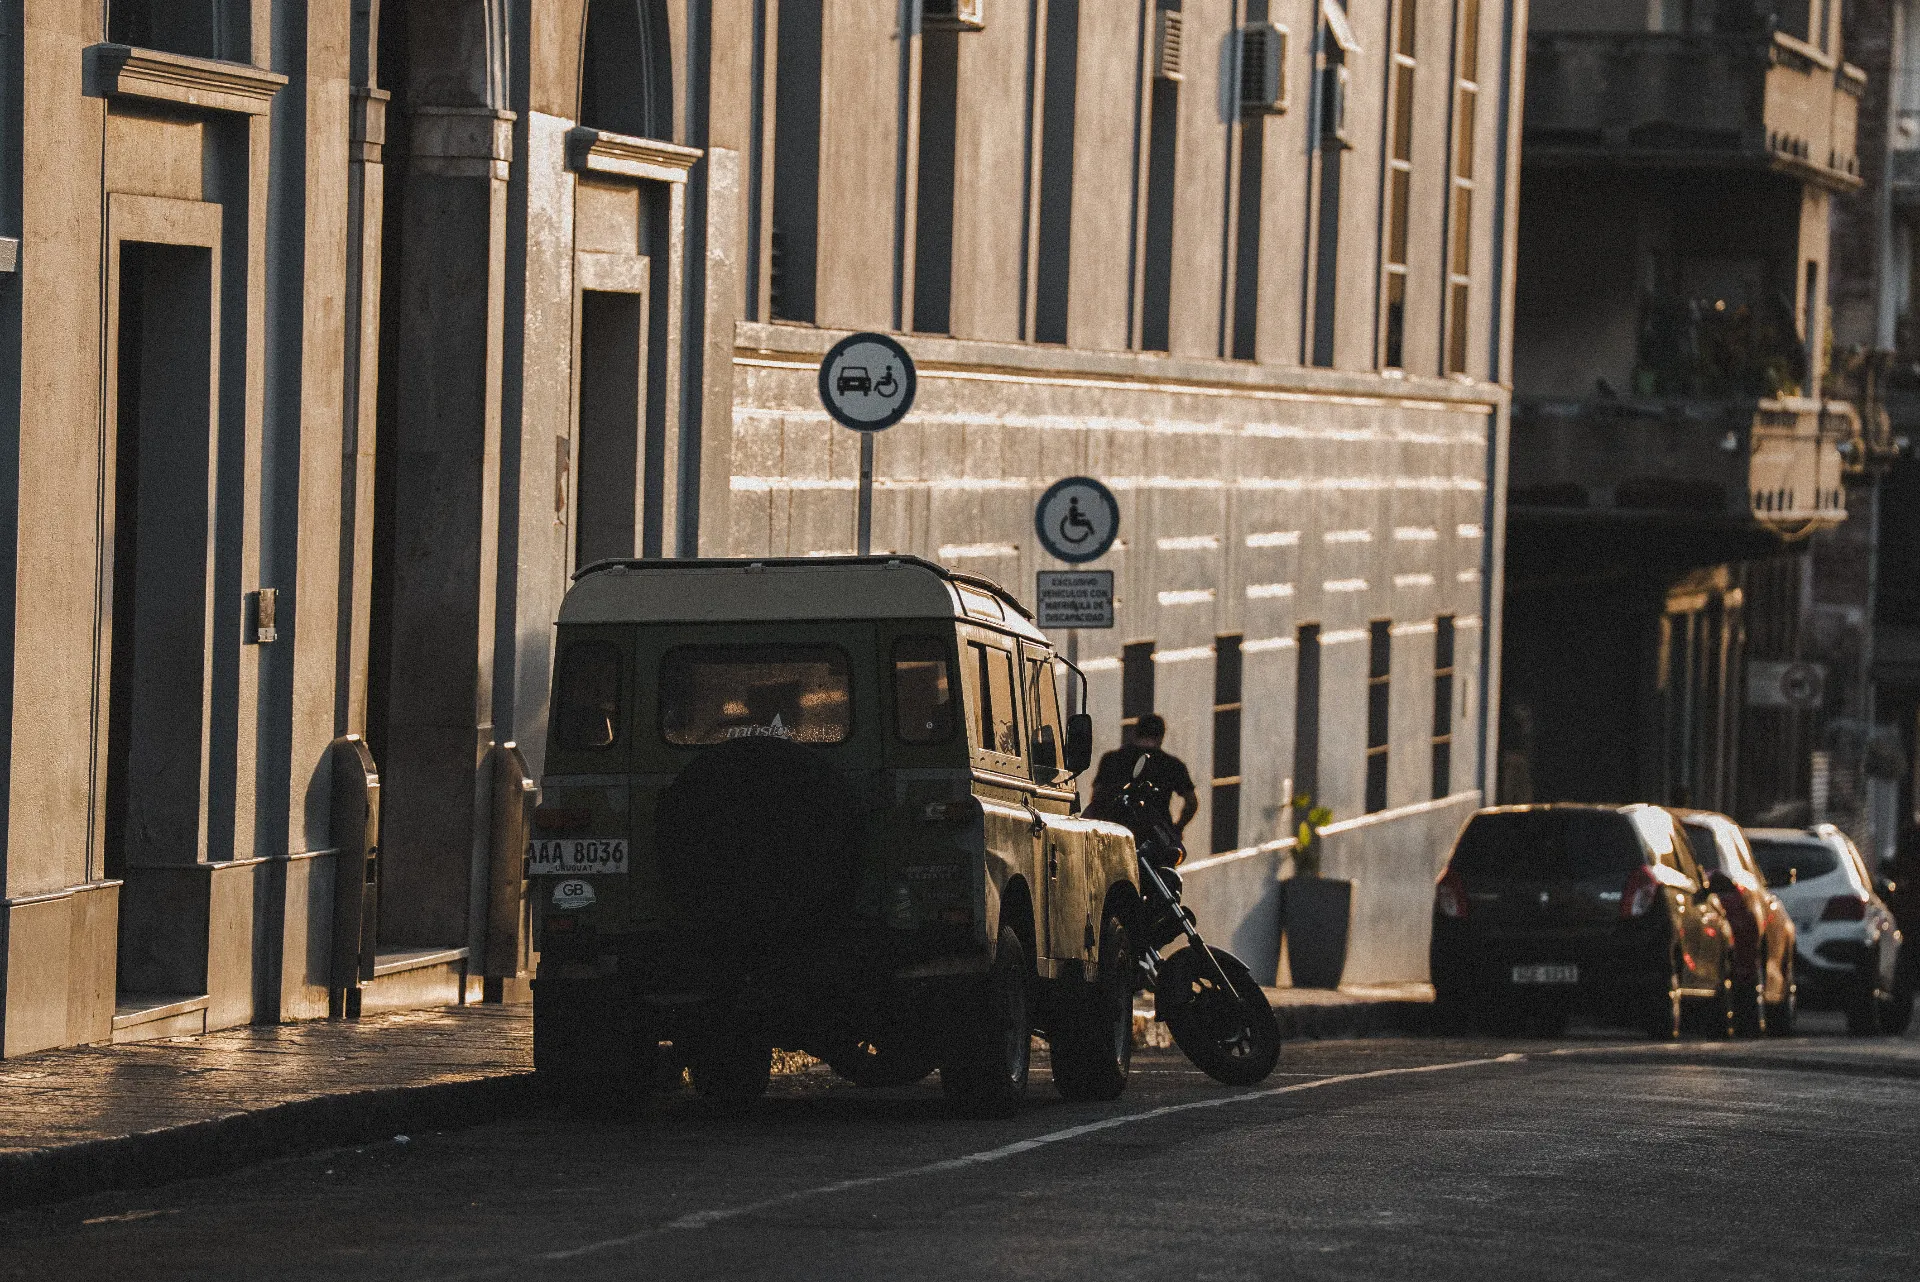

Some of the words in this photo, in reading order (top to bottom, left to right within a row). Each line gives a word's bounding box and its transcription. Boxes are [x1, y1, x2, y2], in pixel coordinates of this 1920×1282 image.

[1052, 578, 1098, 586] EXCLUSIVO
[1090, 589, 1108, 598] CON
[1093, 601, 1104, 610] DE
[1045, 613, 1104, 622] DISCAPACIDAD
[529, 842, 564, 864] AAA
[573, 841, 624, 864] 8036
[555, 864, 593, 872] URUGUAY
[563, 883, 584, 896] GB
